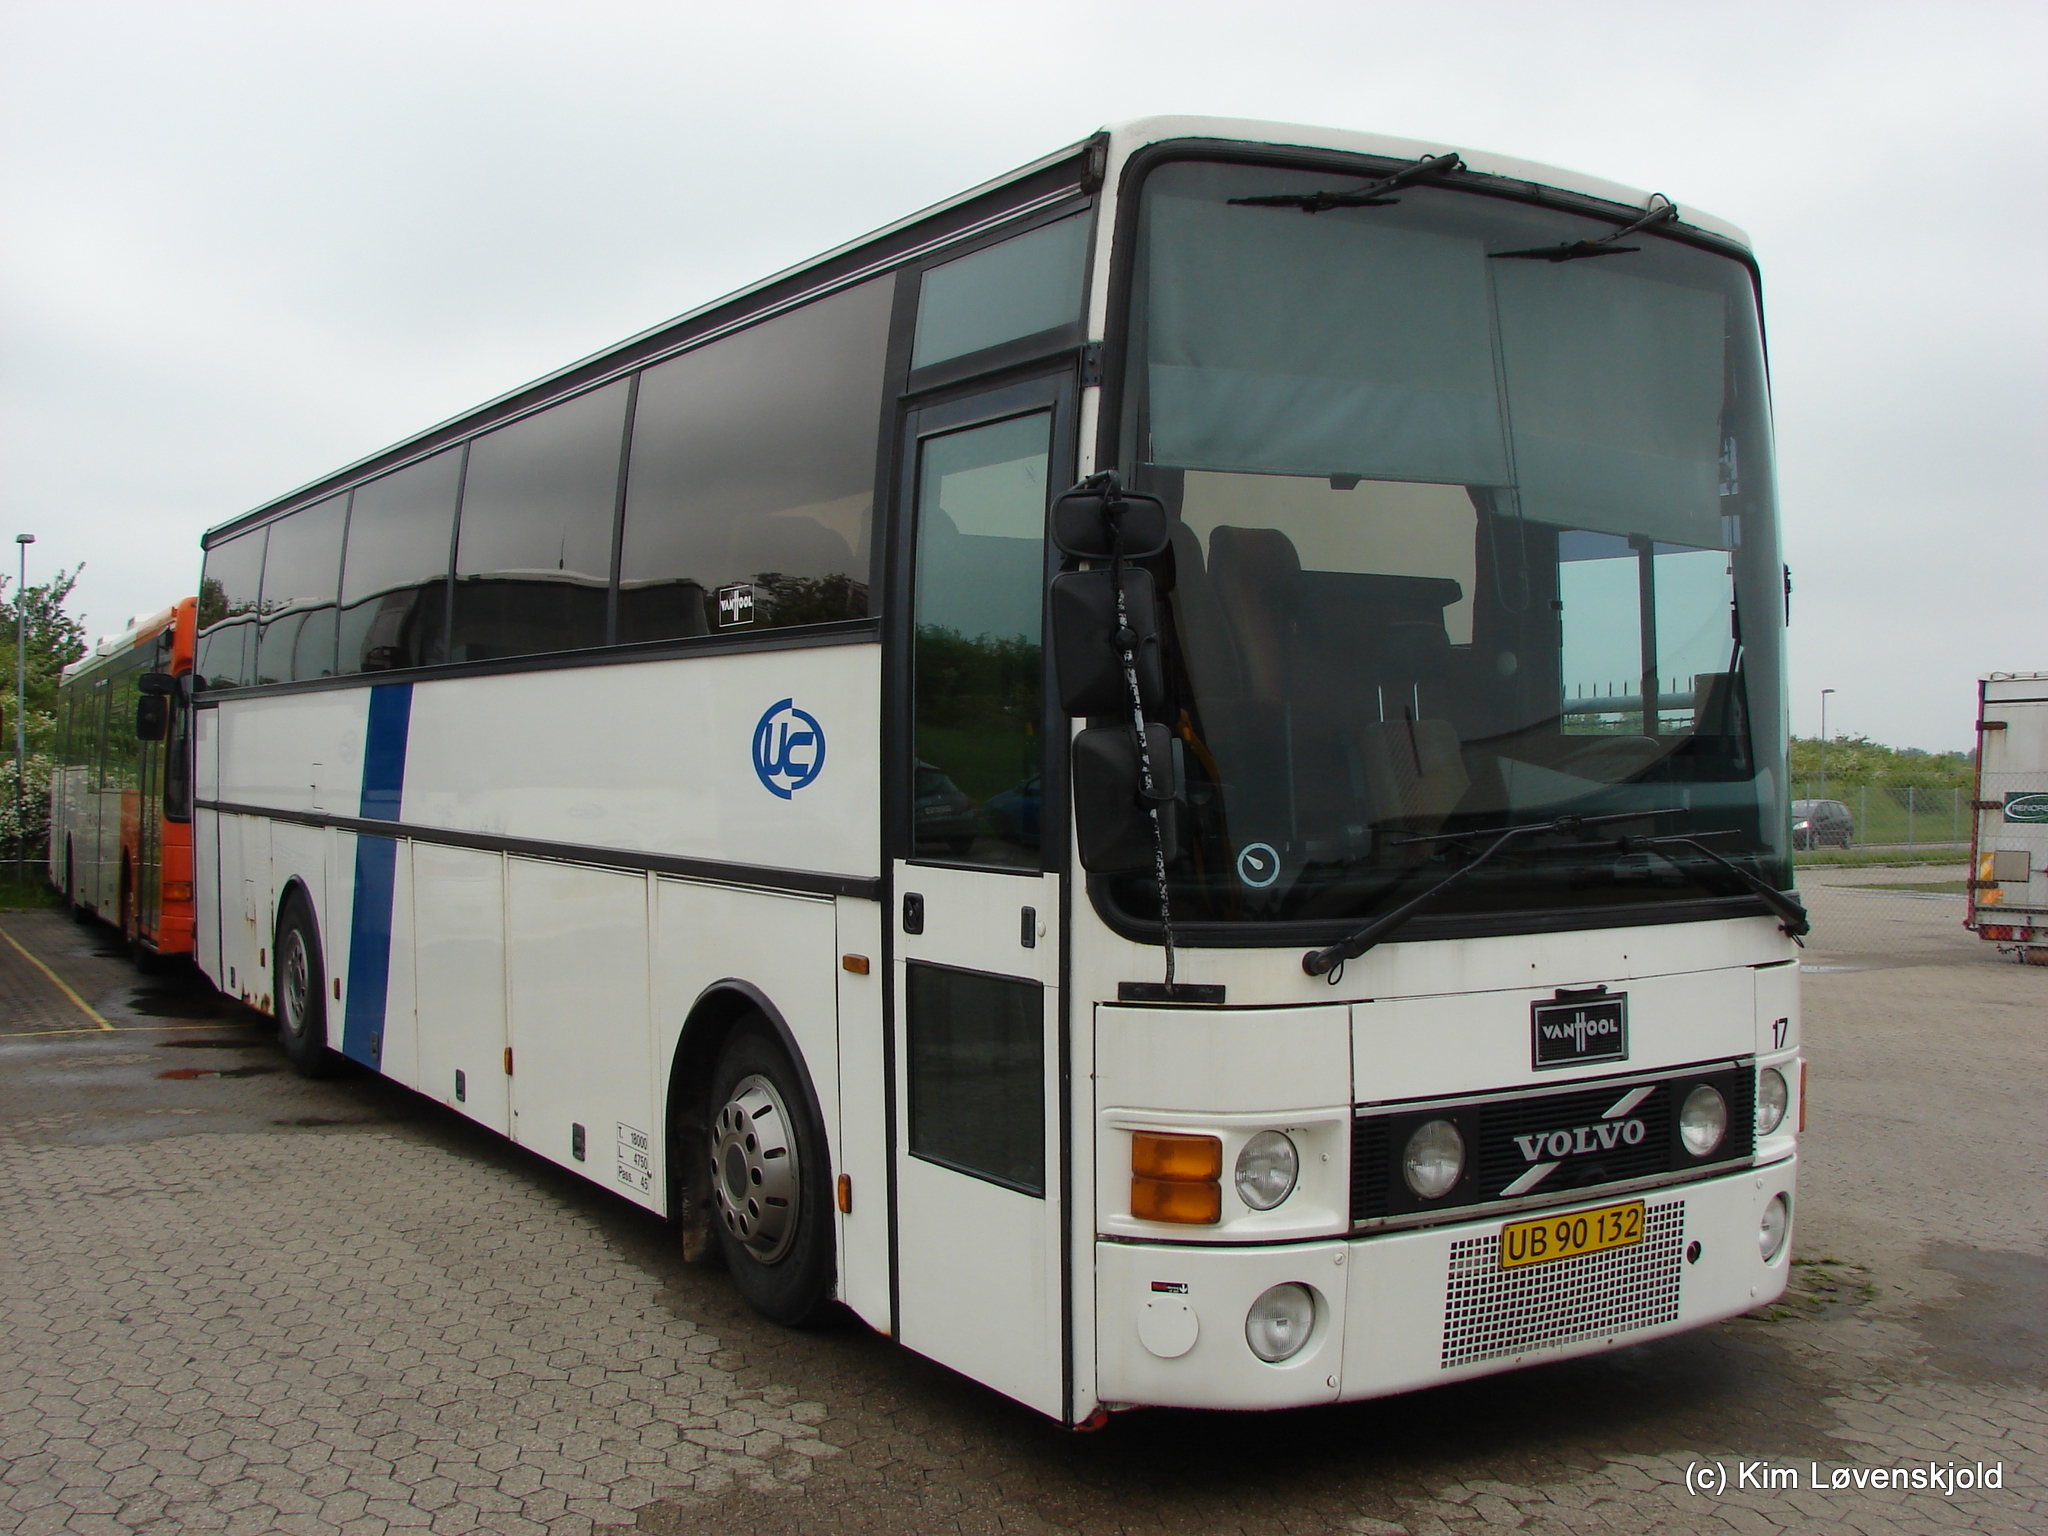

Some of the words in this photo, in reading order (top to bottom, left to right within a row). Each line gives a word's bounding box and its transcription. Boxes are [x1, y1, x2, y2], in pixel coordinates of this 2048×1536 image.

[1772, 1017, 1788, 1050] 17
[1513, 1119, 1646, 1162] VOLVO
[634, 1153, 648, 1170] 4750
[641, 1176, 649, 1190] 45
[1508, 1225, 1548, 1261] UB
[1555, 1217, 1588, 1253] 90
[1597, 1207, 1639, 1244] 132
